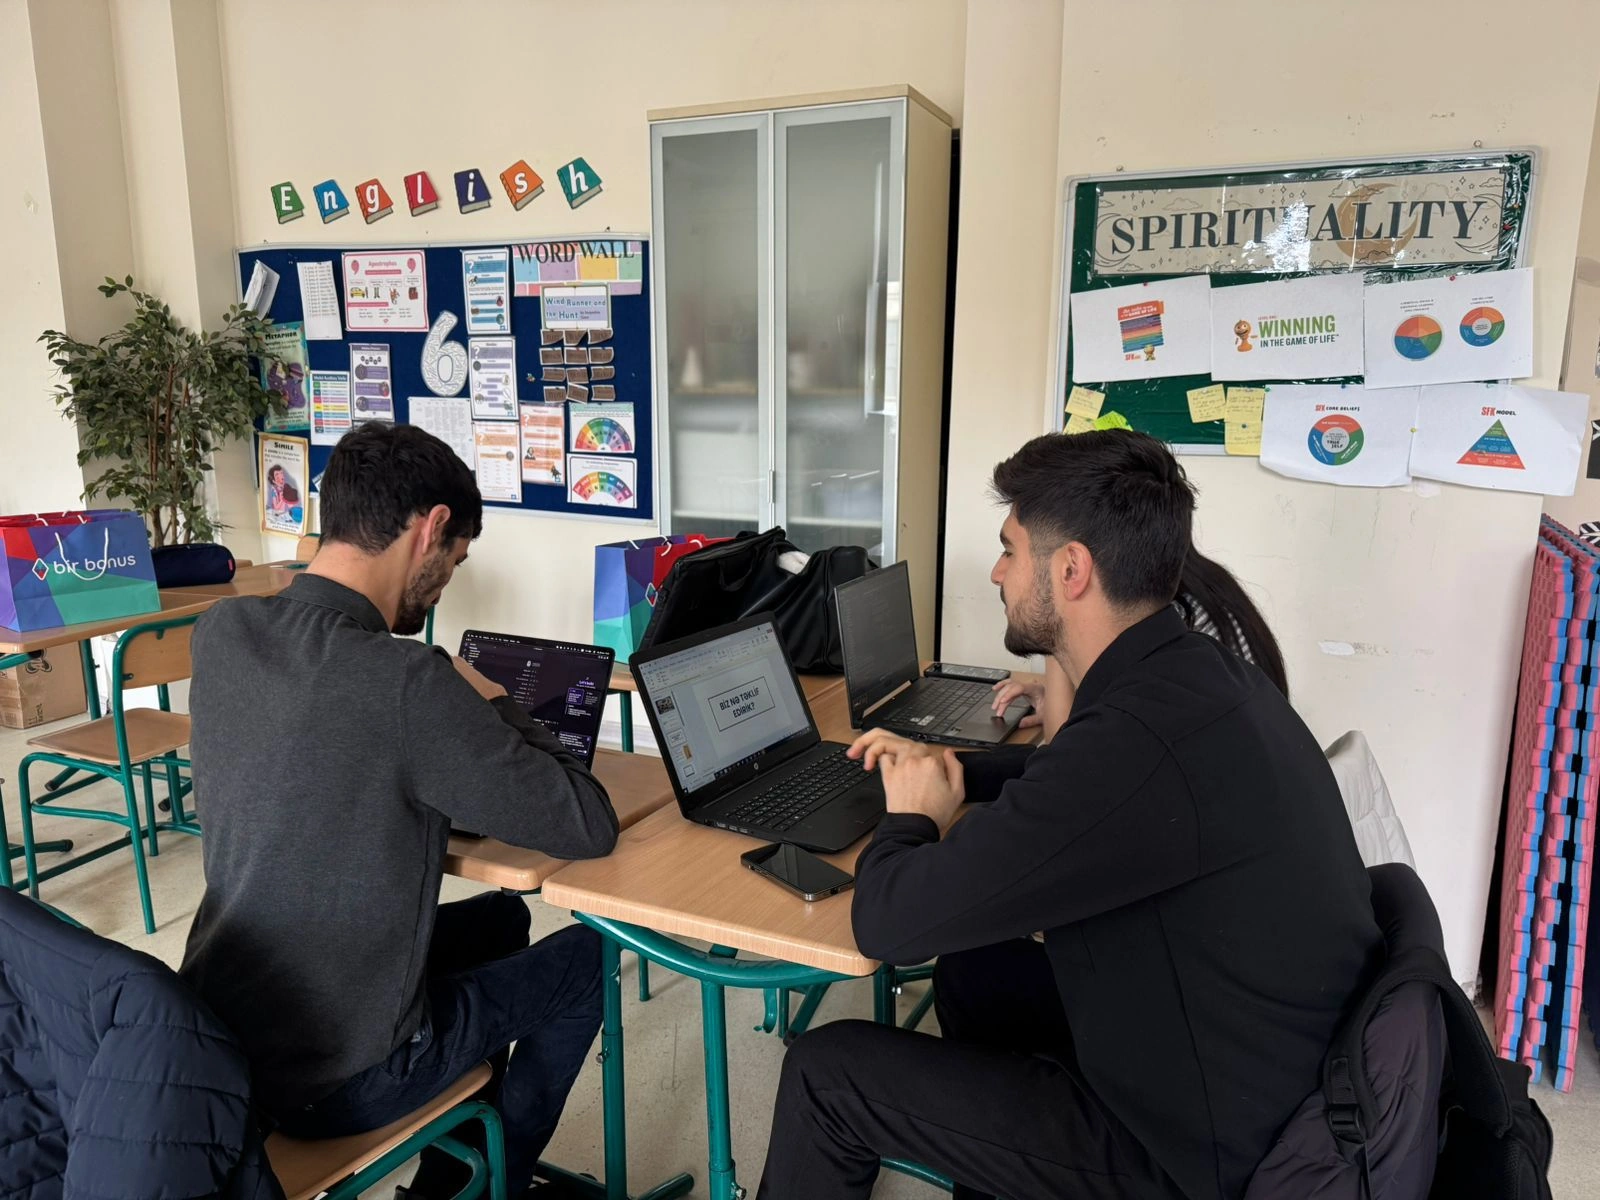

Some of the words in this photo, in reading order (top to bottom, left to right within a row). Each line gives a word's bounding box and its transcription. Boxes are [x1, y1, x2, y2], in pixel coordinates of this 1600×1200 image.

[280, 163, 589, 213] English
[516, 243, 576, 264] WORD
[578, 241, 635, 259] WALL
[545, 296, 565, 305] Wind
[566, 299, 592, 307] Runner
[558, 310, 579, 319] Hunt
[1258, 314, 1336, 339] WINNING
[1260, 339, 1269, 348] IN
[1270, 338, 1284, 347] THE
[1285, 336, 1307, 346] GAME
[1308, 335, 1319, 344] OF
[1481, 406, 1496, 416] SFK
[274, 442, 294, 450] SIMILE
[53, 560, 79, 575] bir
[84, 555, 137, 571] bonus
